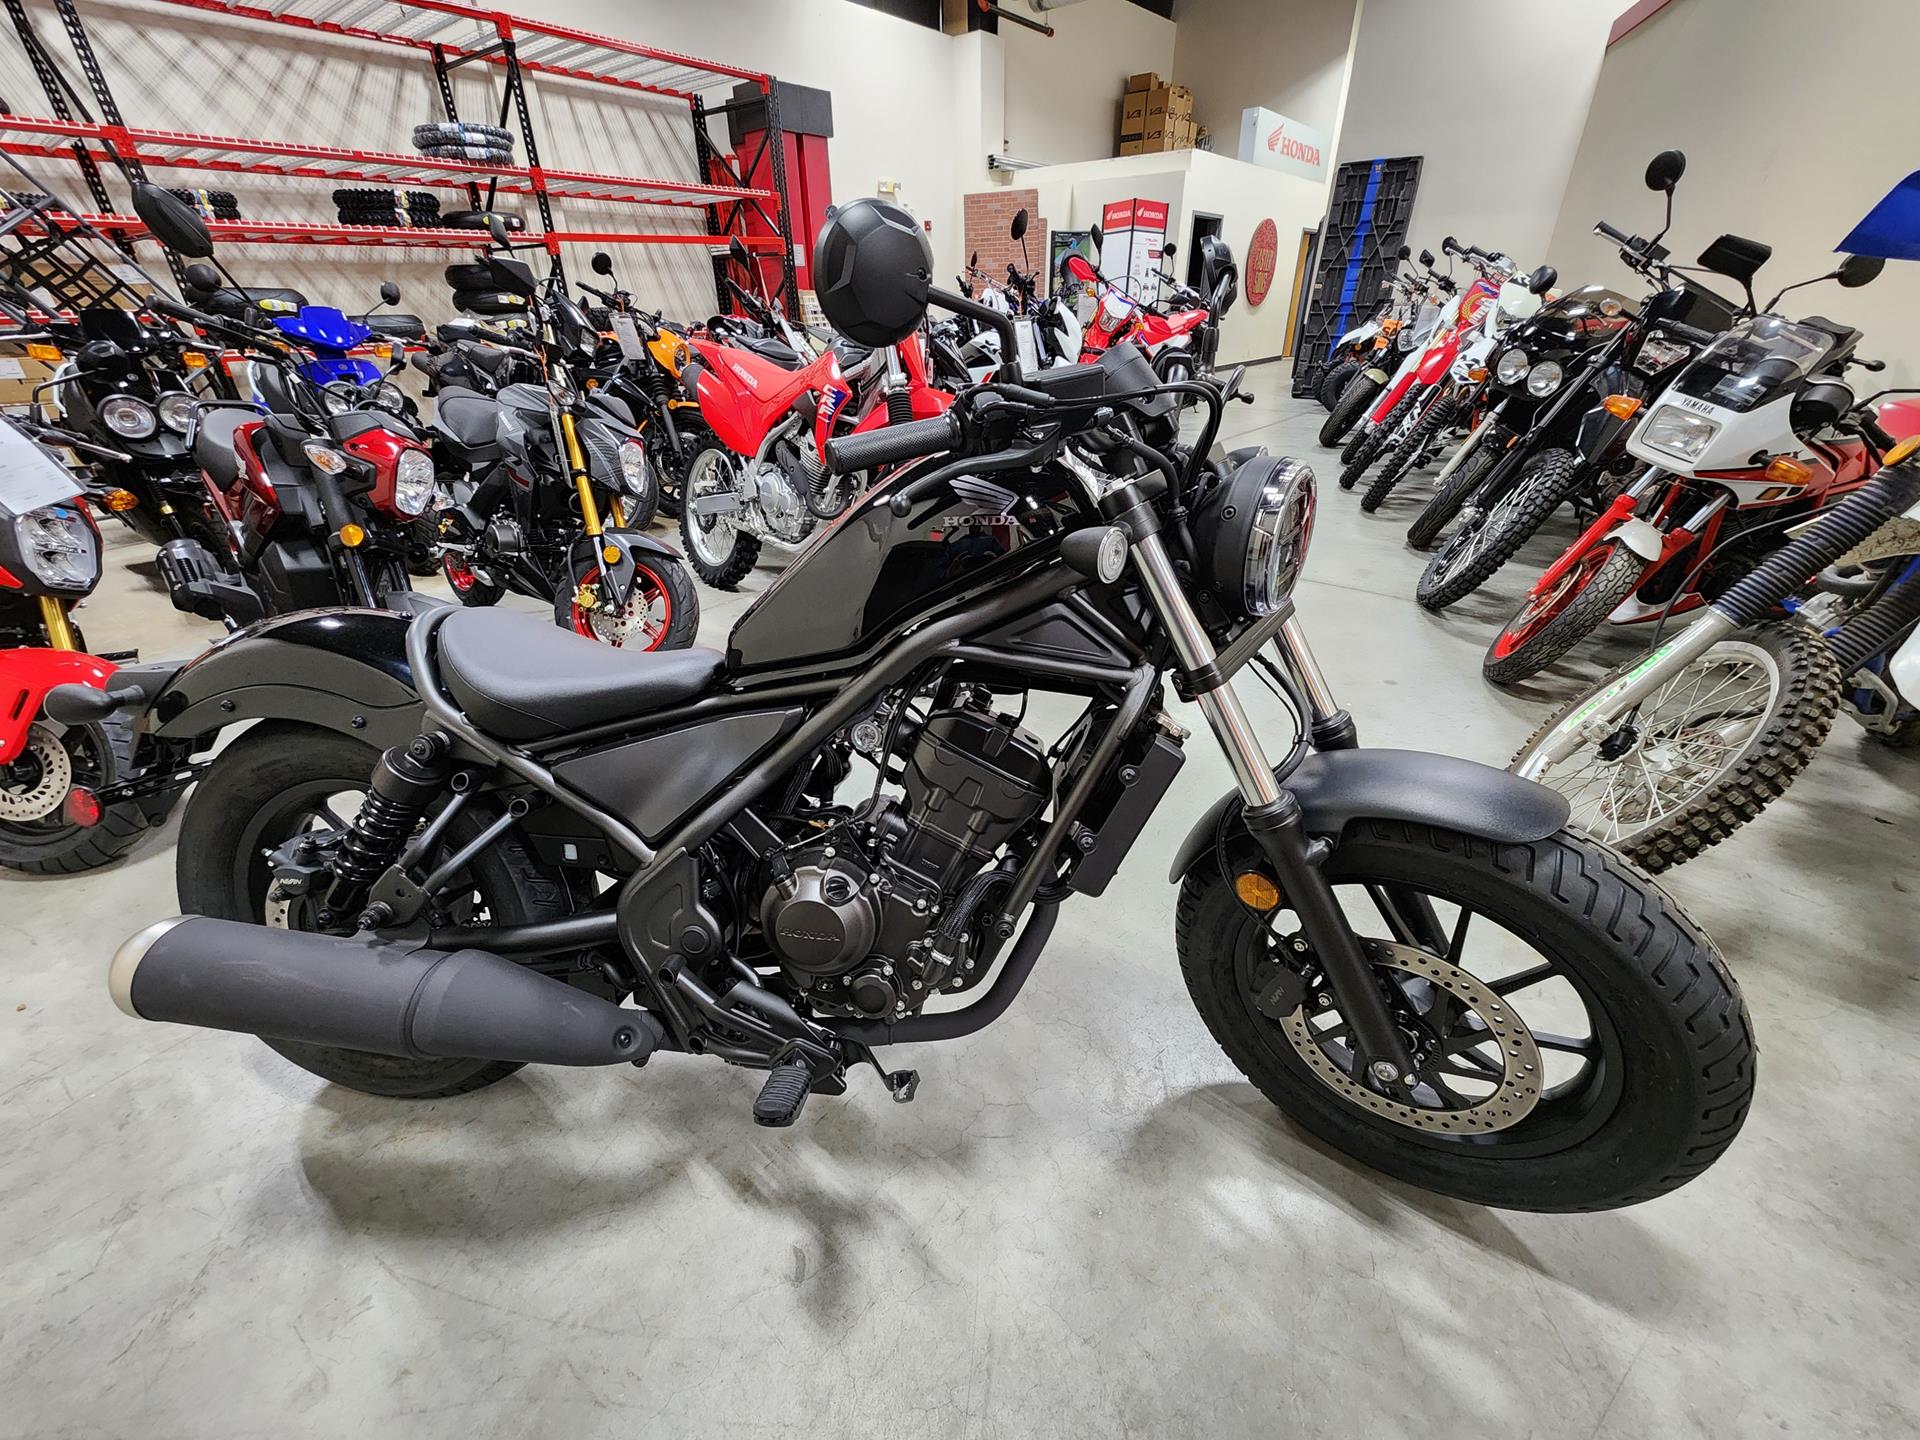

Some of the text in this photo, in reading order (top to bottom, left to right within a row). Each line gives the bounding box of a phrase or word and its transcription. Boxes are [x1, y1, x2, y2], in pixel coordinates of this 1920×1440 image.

[1280, 135, 1320, 166] HONDA
[1111, 209, 1131, 220] HONDA
[1142, 210, 1164, 220] HONDA
[731, 363, 759, 389] HONDA
[1681, 397, 1715, 416] YAMAHA
[943, 515, 1021, 527] HONDA
[778, 926, 841, 942] HONDA
